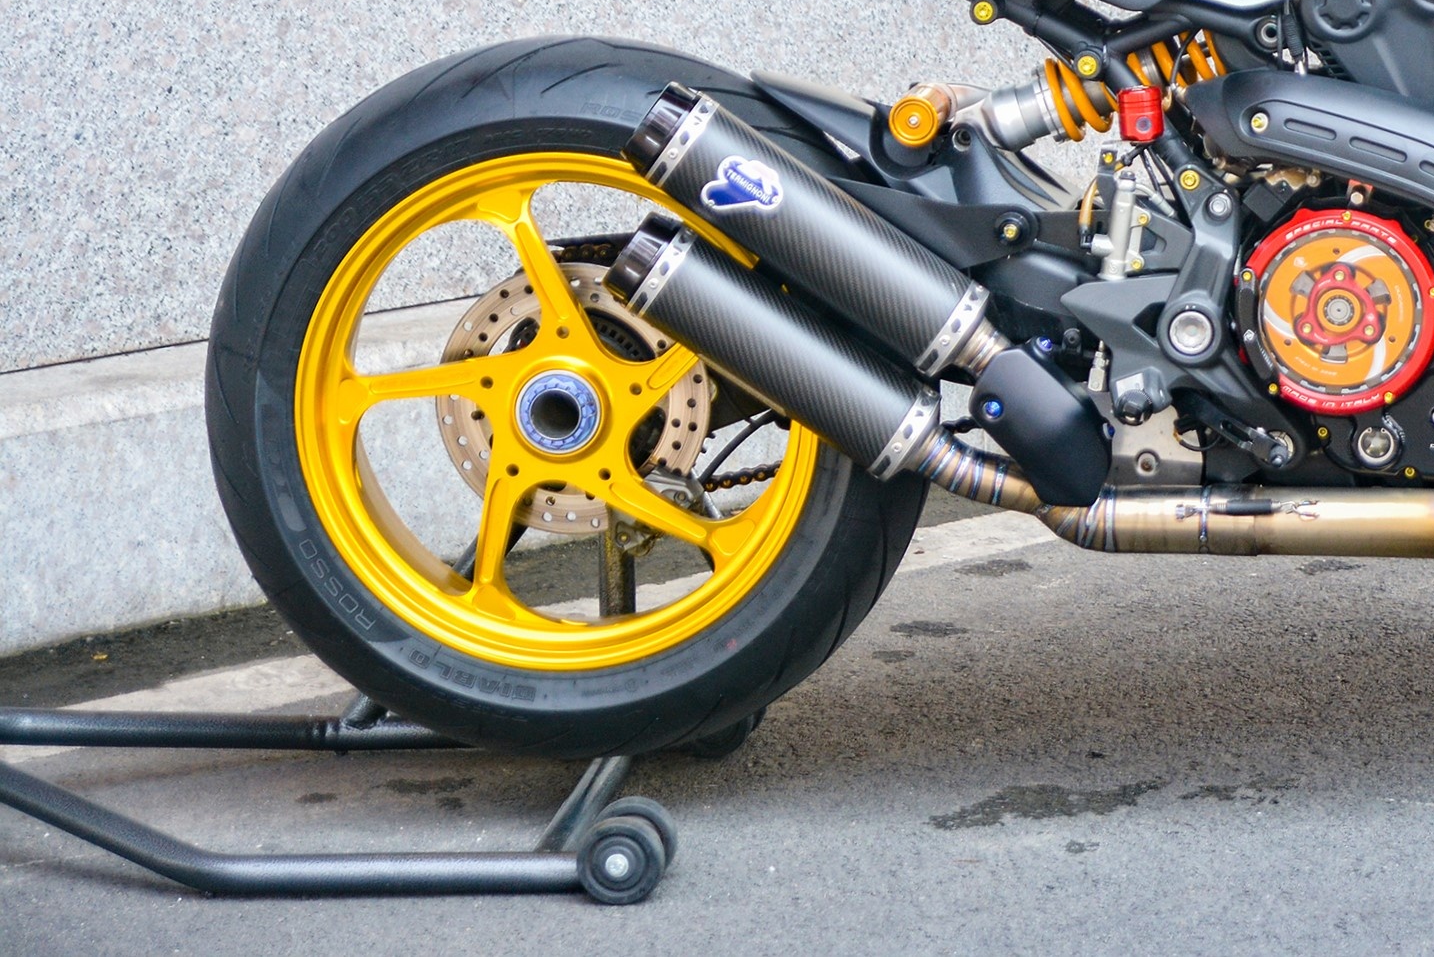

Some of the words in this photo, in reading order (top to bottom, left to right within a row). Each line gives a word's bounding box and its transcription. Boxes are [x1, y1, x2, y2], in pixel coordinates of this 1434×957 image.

[726, 168, 771, 203] TERMIGNONI
[1285, 219, 1345, 241] SPECIAL
[1350, 221, 1398, 244] PARTS
[1281, 384, 1317, 405] MADE
[1340, 393, 1381, 408] ITALY
[299, 539, 377, 633] ROSSO
